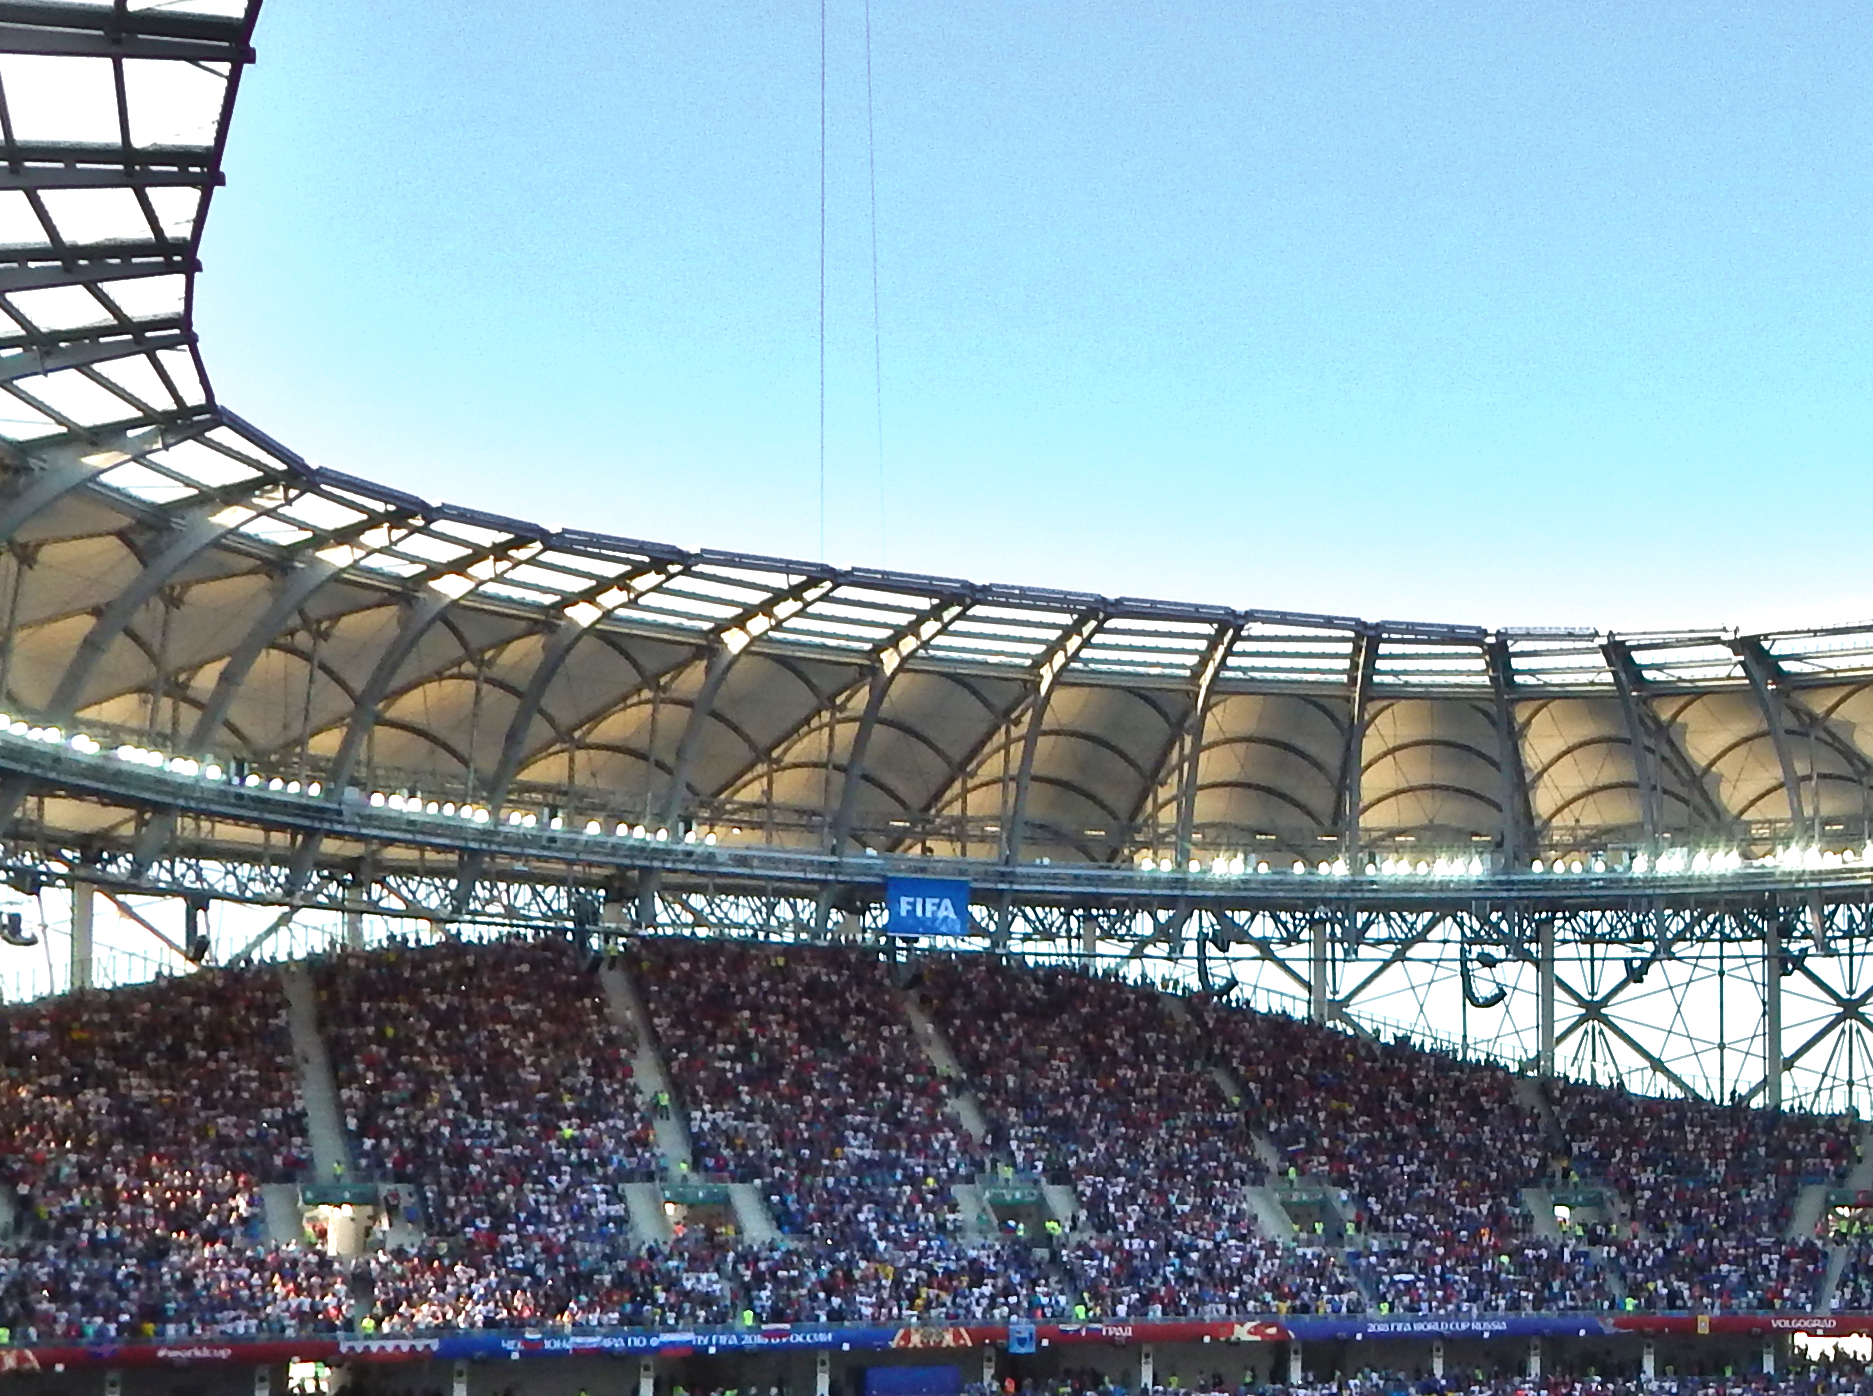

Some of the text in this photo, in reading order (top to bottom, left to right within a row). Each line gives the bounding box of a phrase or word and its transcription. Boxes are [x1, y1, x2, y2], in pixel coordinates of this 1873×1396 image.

[900, 895, 957, 919] FIFA
[1367, 1322, 1388, 1333] 2018
[1390, 1322, 1411, 1332] FIFA
[1413, 1321, 1448, 1332] WORLD
[1449, 1321, 1470, 1331] CUP
[1771, 1318, 1836, 1329] VOLGOGRAD
